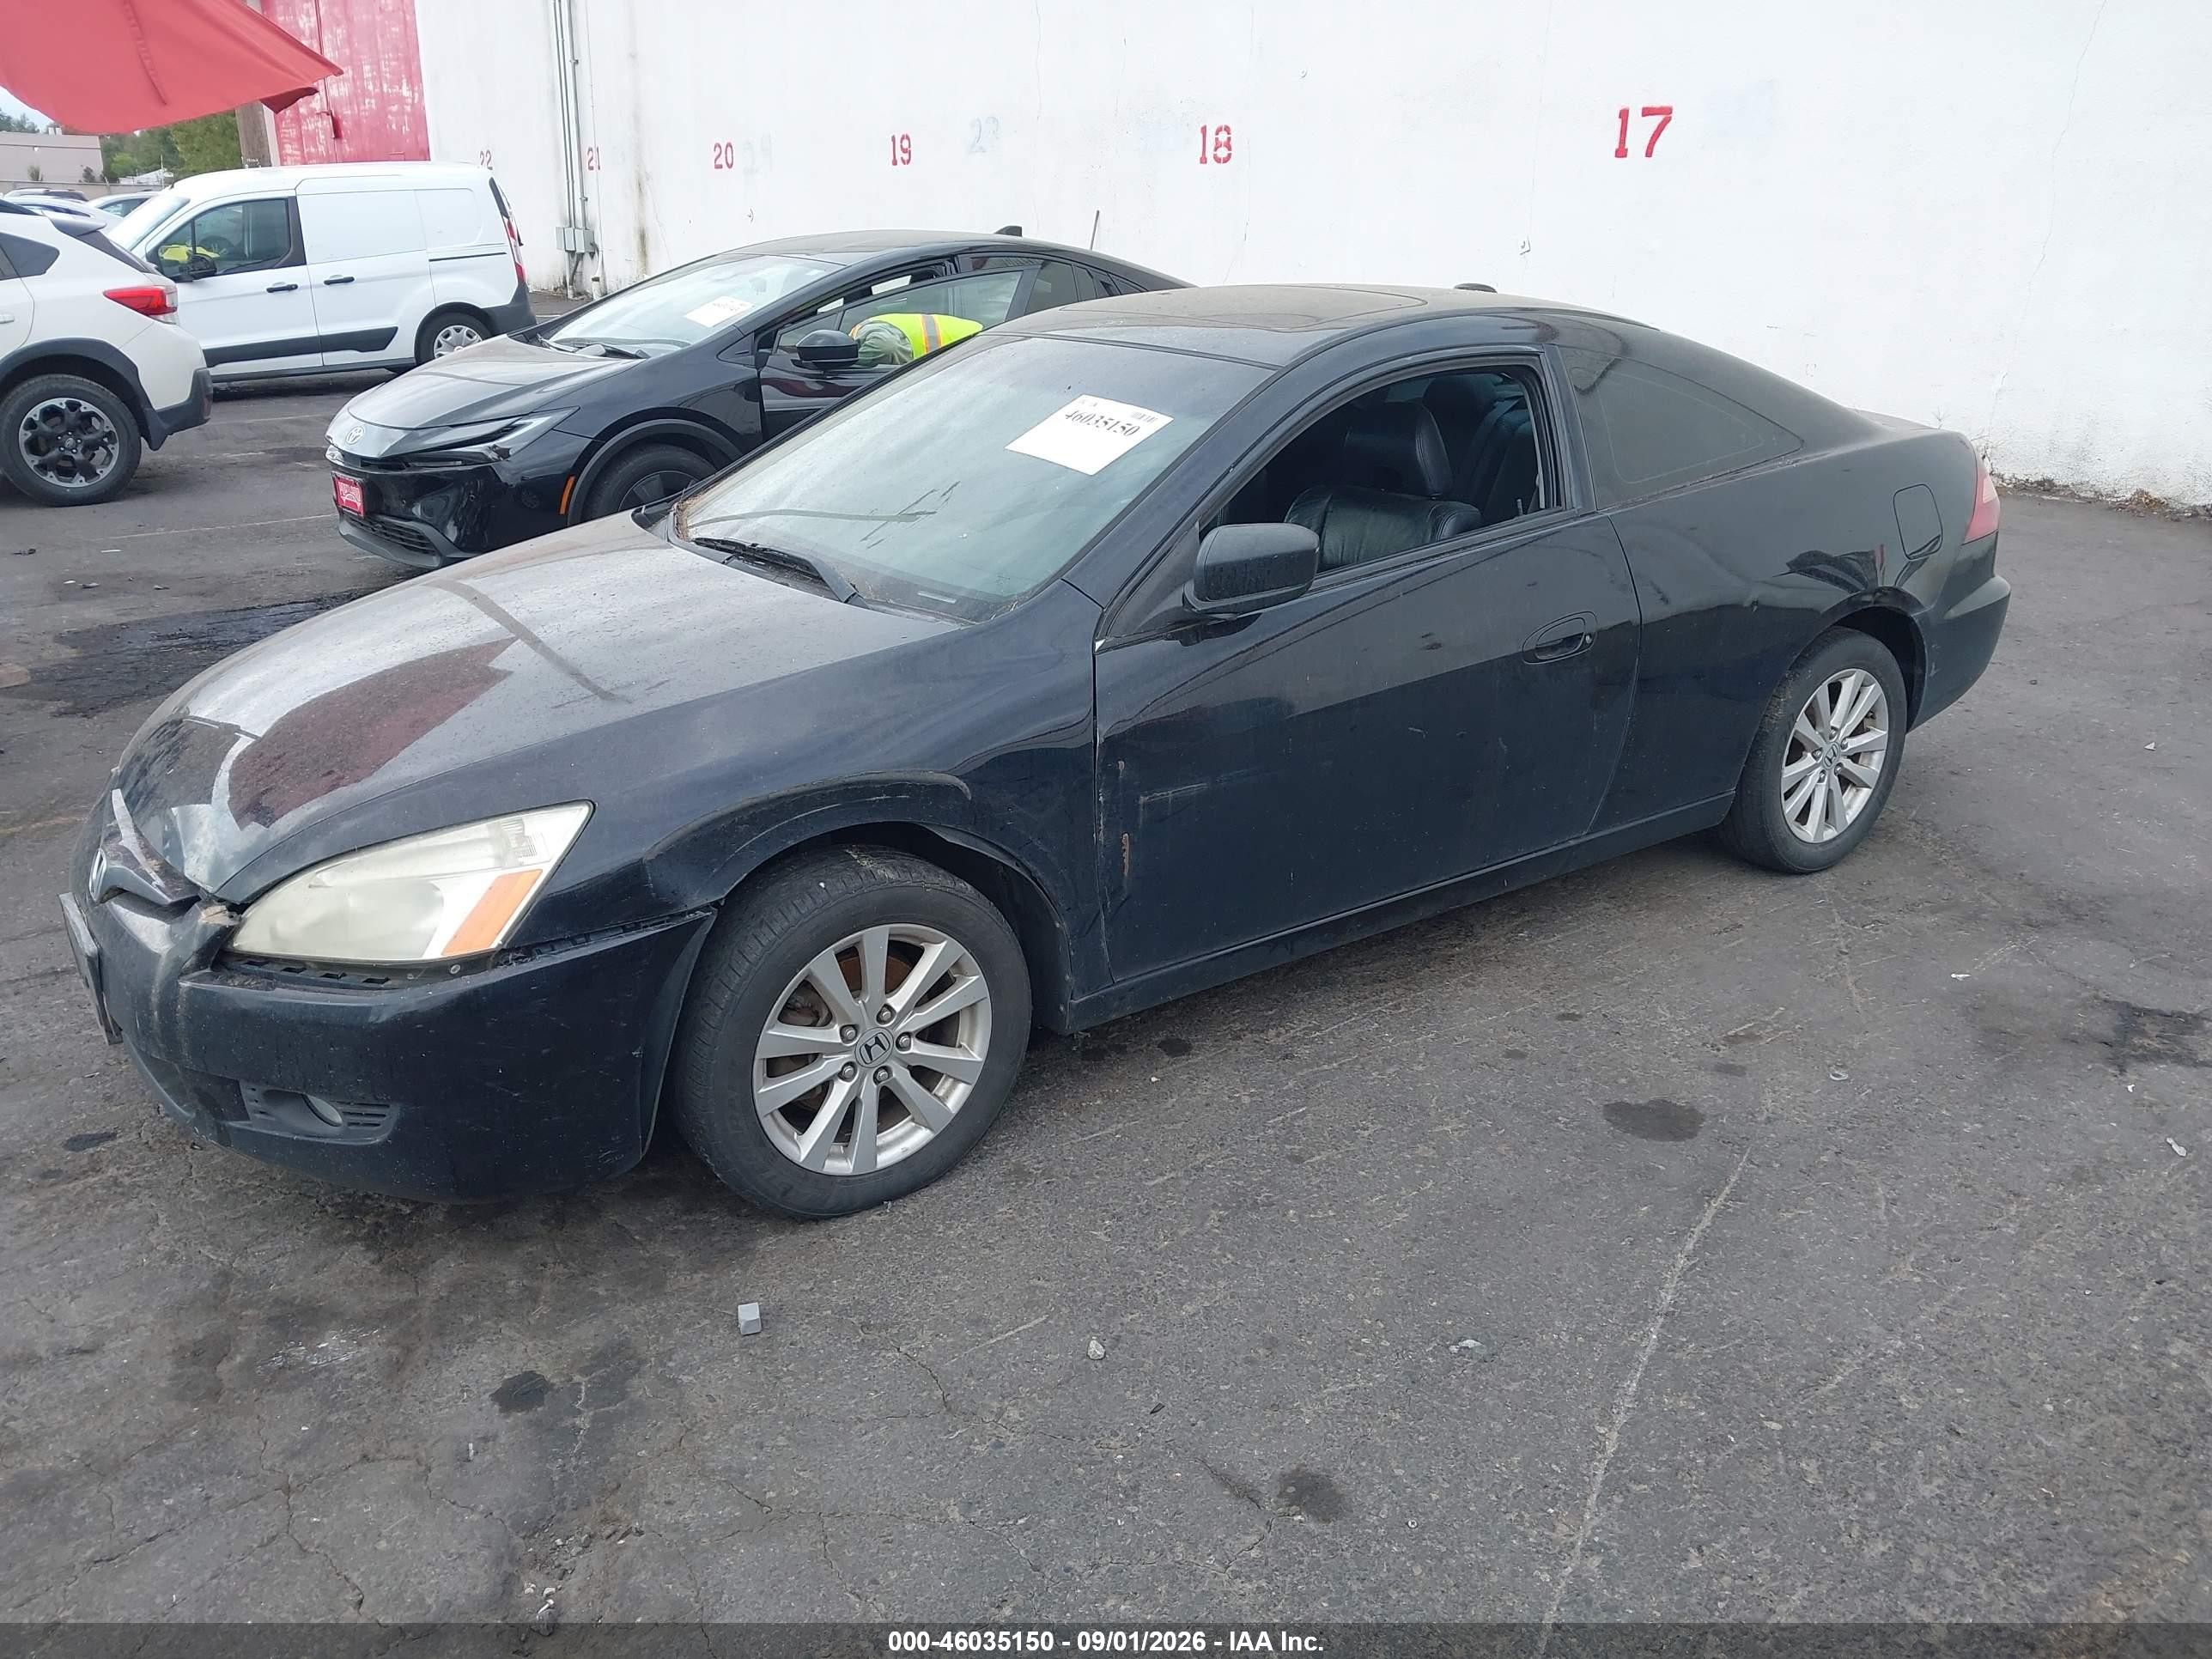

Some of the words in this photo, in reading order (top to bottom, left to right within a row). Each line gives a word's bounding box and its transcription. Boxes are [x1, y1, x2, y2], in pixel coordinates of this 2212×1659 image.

[1200, 125, 1232, 164] 18
[1615, 106, 1674, 158] 17
[587, 147, 601, 171] 21
[714, 142, 734, 169] 20
[891, 133, 911, 166] 19
[1065, 410, 1141, 437] 46035150
